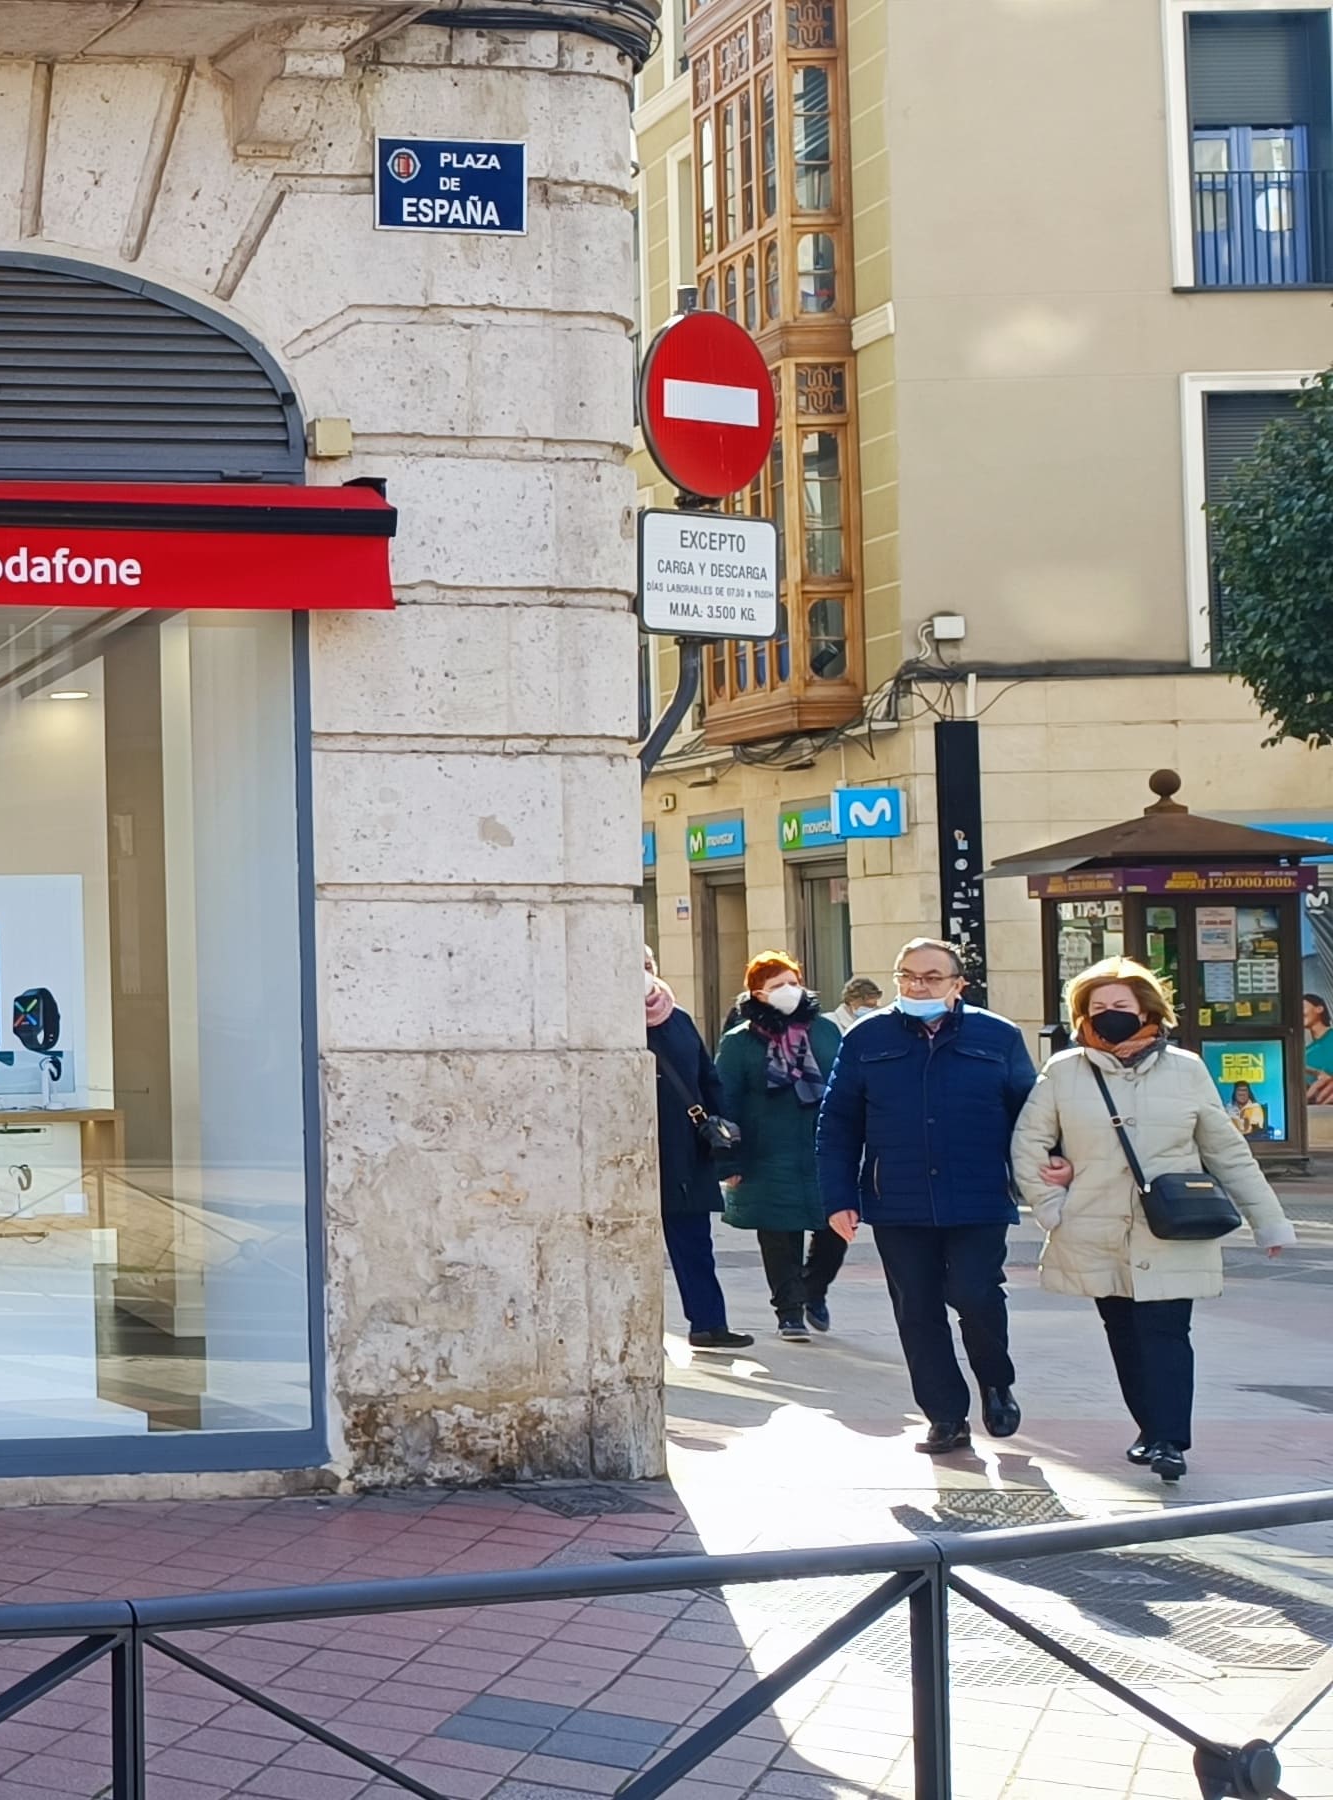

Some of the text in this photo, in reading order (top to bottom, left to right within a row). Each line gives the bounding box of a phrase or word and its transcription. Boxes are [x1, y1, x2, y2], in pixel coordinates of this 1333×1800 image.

[439, 152, 501, 170] PLAZA
[439, 176, 461, 191] DE
[402, 195, 501, 226] ESPAÑA
[679, 530, 746, 553] EXCEPTO
[657, 559, 768, 581] CARGA Y DESCARGA
[801, 818, 831, 834] movista
[1221, 1053, 1264, 1067] BIEN
